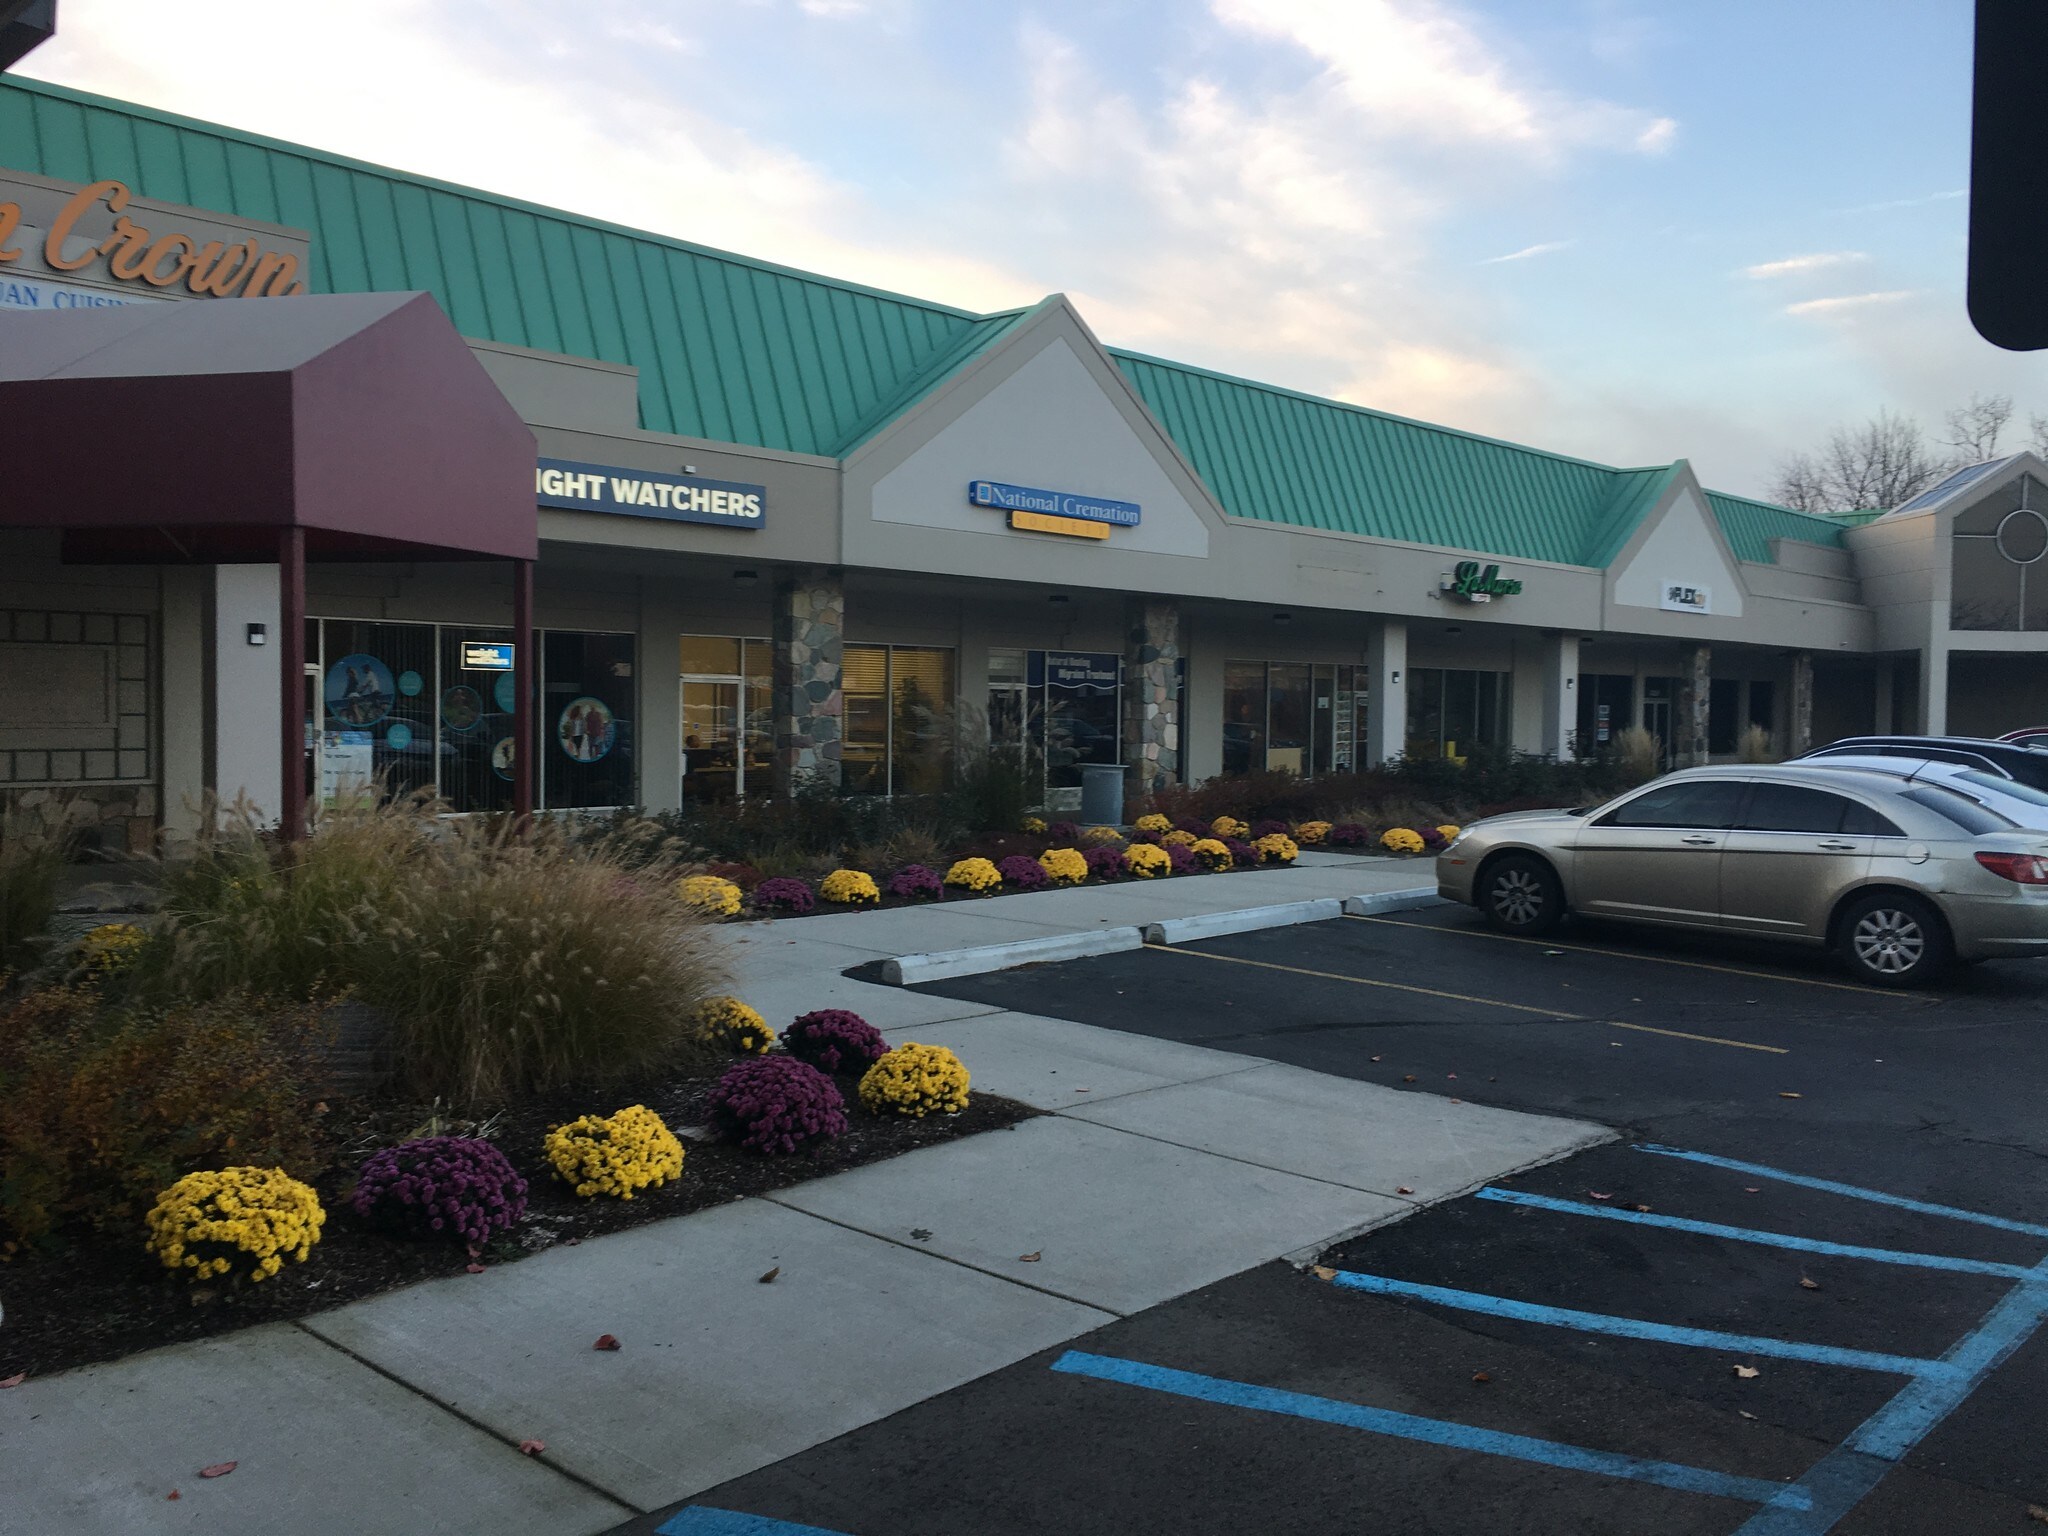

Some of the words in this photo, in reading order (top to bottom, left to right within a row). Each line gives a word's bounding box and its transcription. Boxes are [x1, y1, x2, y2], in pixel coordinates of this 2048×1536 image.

[46, 180, 304, 299] Crown
[611, 477, 761, 519] WATCHERS
[993, 487, 1059, 512] National
[1063, 498, 1139, 523] Cremation
[1015, 515, 1106, 537] SOCIETY
